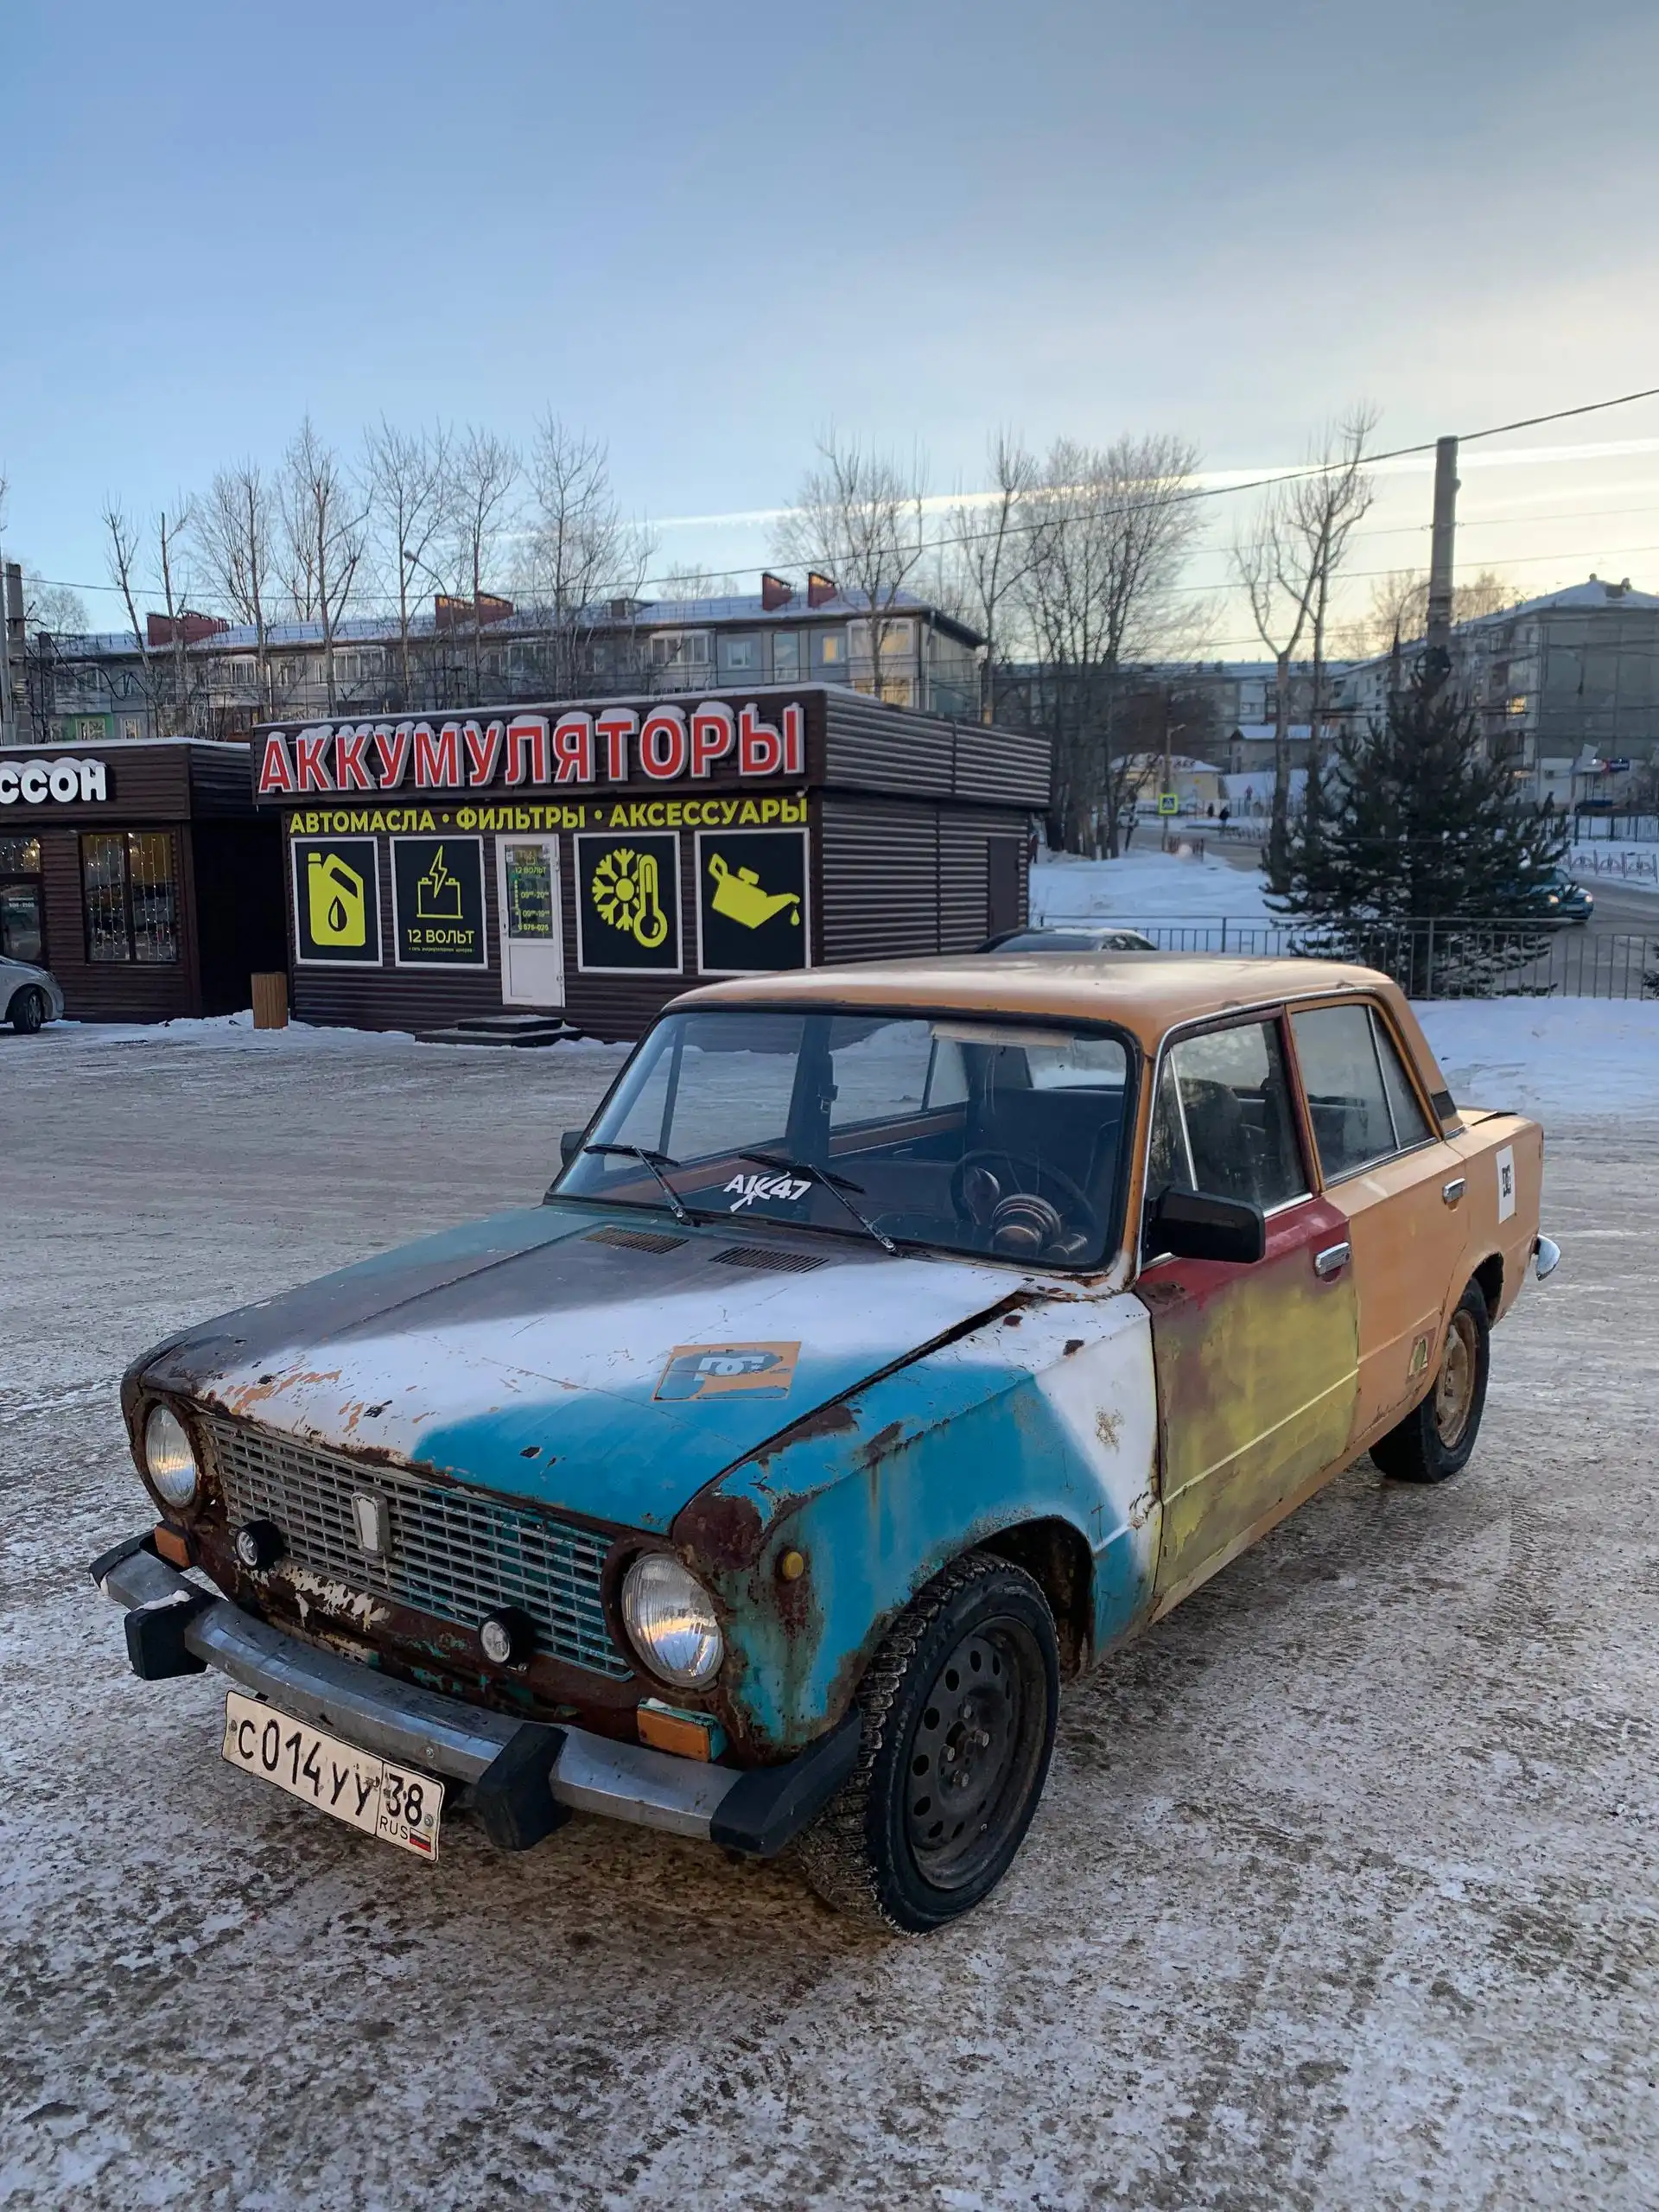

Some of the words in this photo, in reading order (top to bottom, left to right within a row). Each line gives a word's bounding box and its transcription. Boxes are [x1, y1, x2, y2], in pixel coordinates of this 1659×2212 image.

[257, 704, 804, 793] АККУМУЛЯТОРЫ
[289, 809, 436, 834] АВТОМАСЛА
[456, 804, 586, 831] ФИЛЬТРЫ
[609, 797, 808, 828] АКСЕССУАРЫ
[407, 929, 422, 944] 12
[426, 929, 475, 944] ВОЛЬТ
[378, 1815, 409, 1840] RUS
